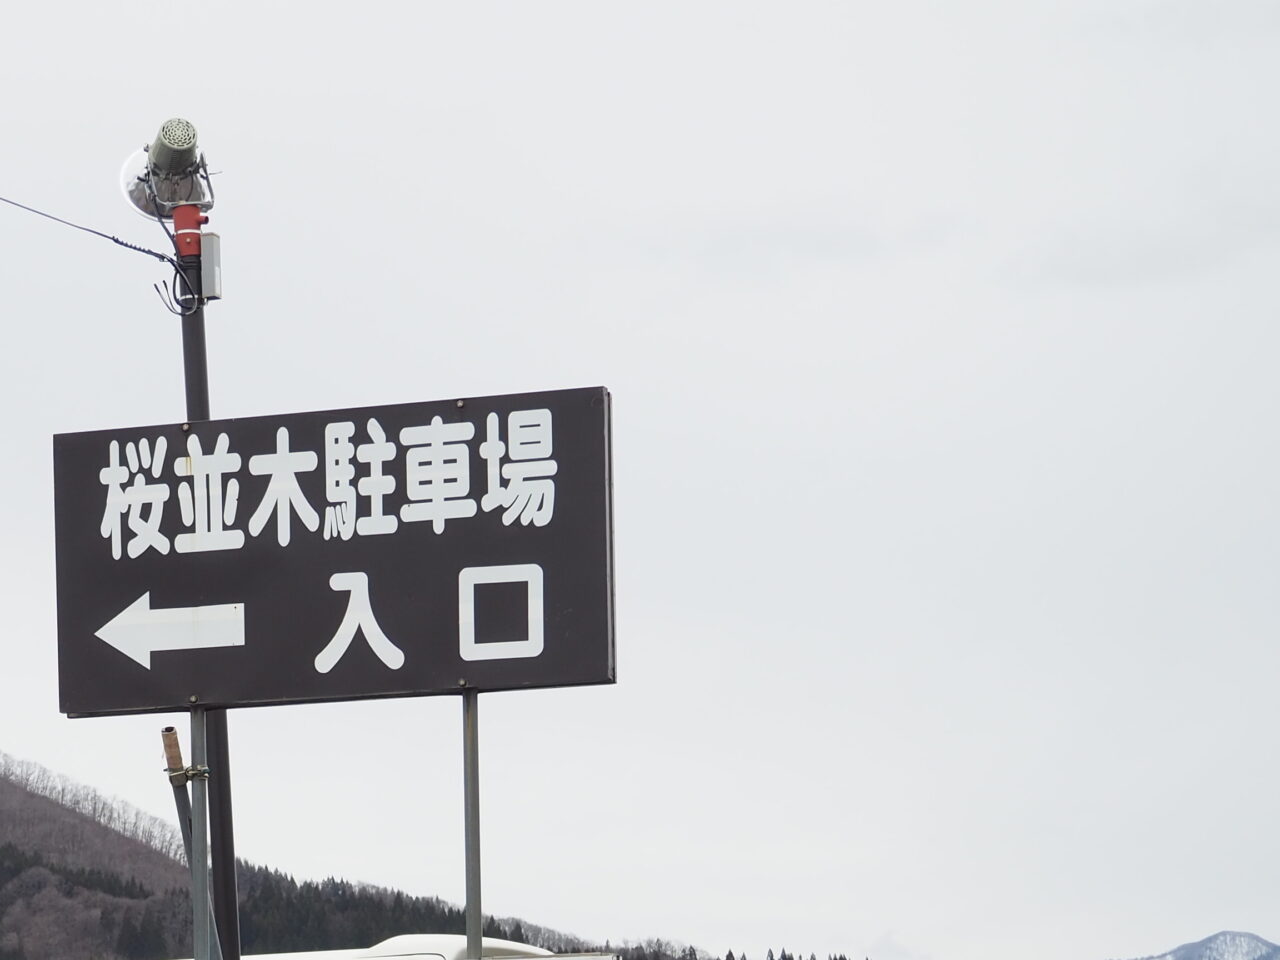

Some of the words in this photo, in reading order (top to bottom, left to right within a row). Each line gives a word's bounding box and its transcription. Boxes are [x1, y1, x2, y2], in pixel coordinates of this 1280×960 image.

[98, 407, 558, 561] 桜並木駐車場
[314, 563, 545, 674] 入口
